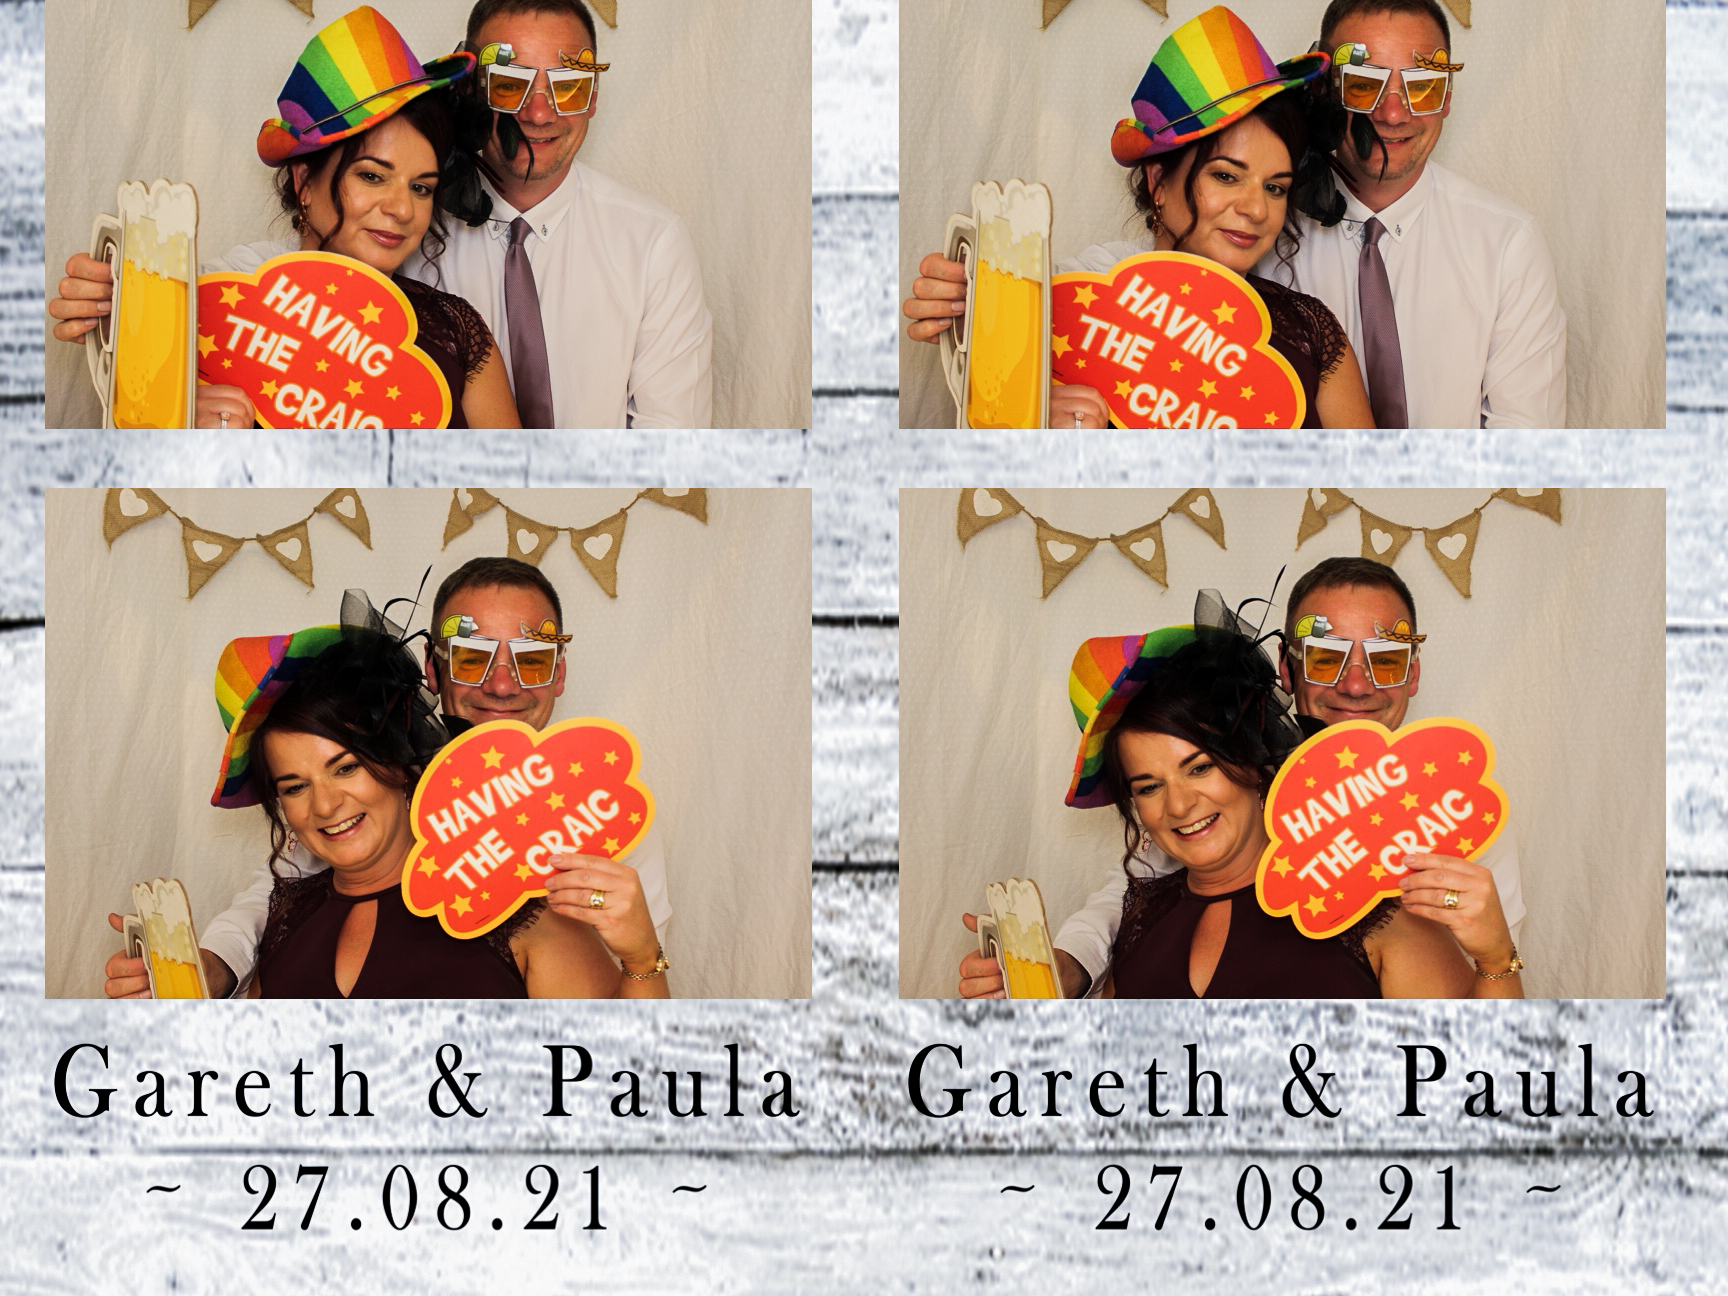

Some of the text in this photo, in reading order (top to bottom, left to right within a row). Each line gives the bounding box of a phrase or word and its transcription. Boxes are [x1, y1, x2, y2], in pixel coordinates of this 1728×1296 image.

[227, 315, 301, 372] THE
[263, 275, 393, 377] HAVING
[1081, 315, 1155, 372] THE
[1117, 275, 1247, 377] HAVING
[427, 754, 554, 843] HAVING
[525, 789, 619, 875] CRAIC
[1281, 754, 1408, 843] HAVING
[1379, 789, 1473, 875] CRAIC
[443, 828, 514, 889] THE
[1297, 828, 1368, 889] THE
